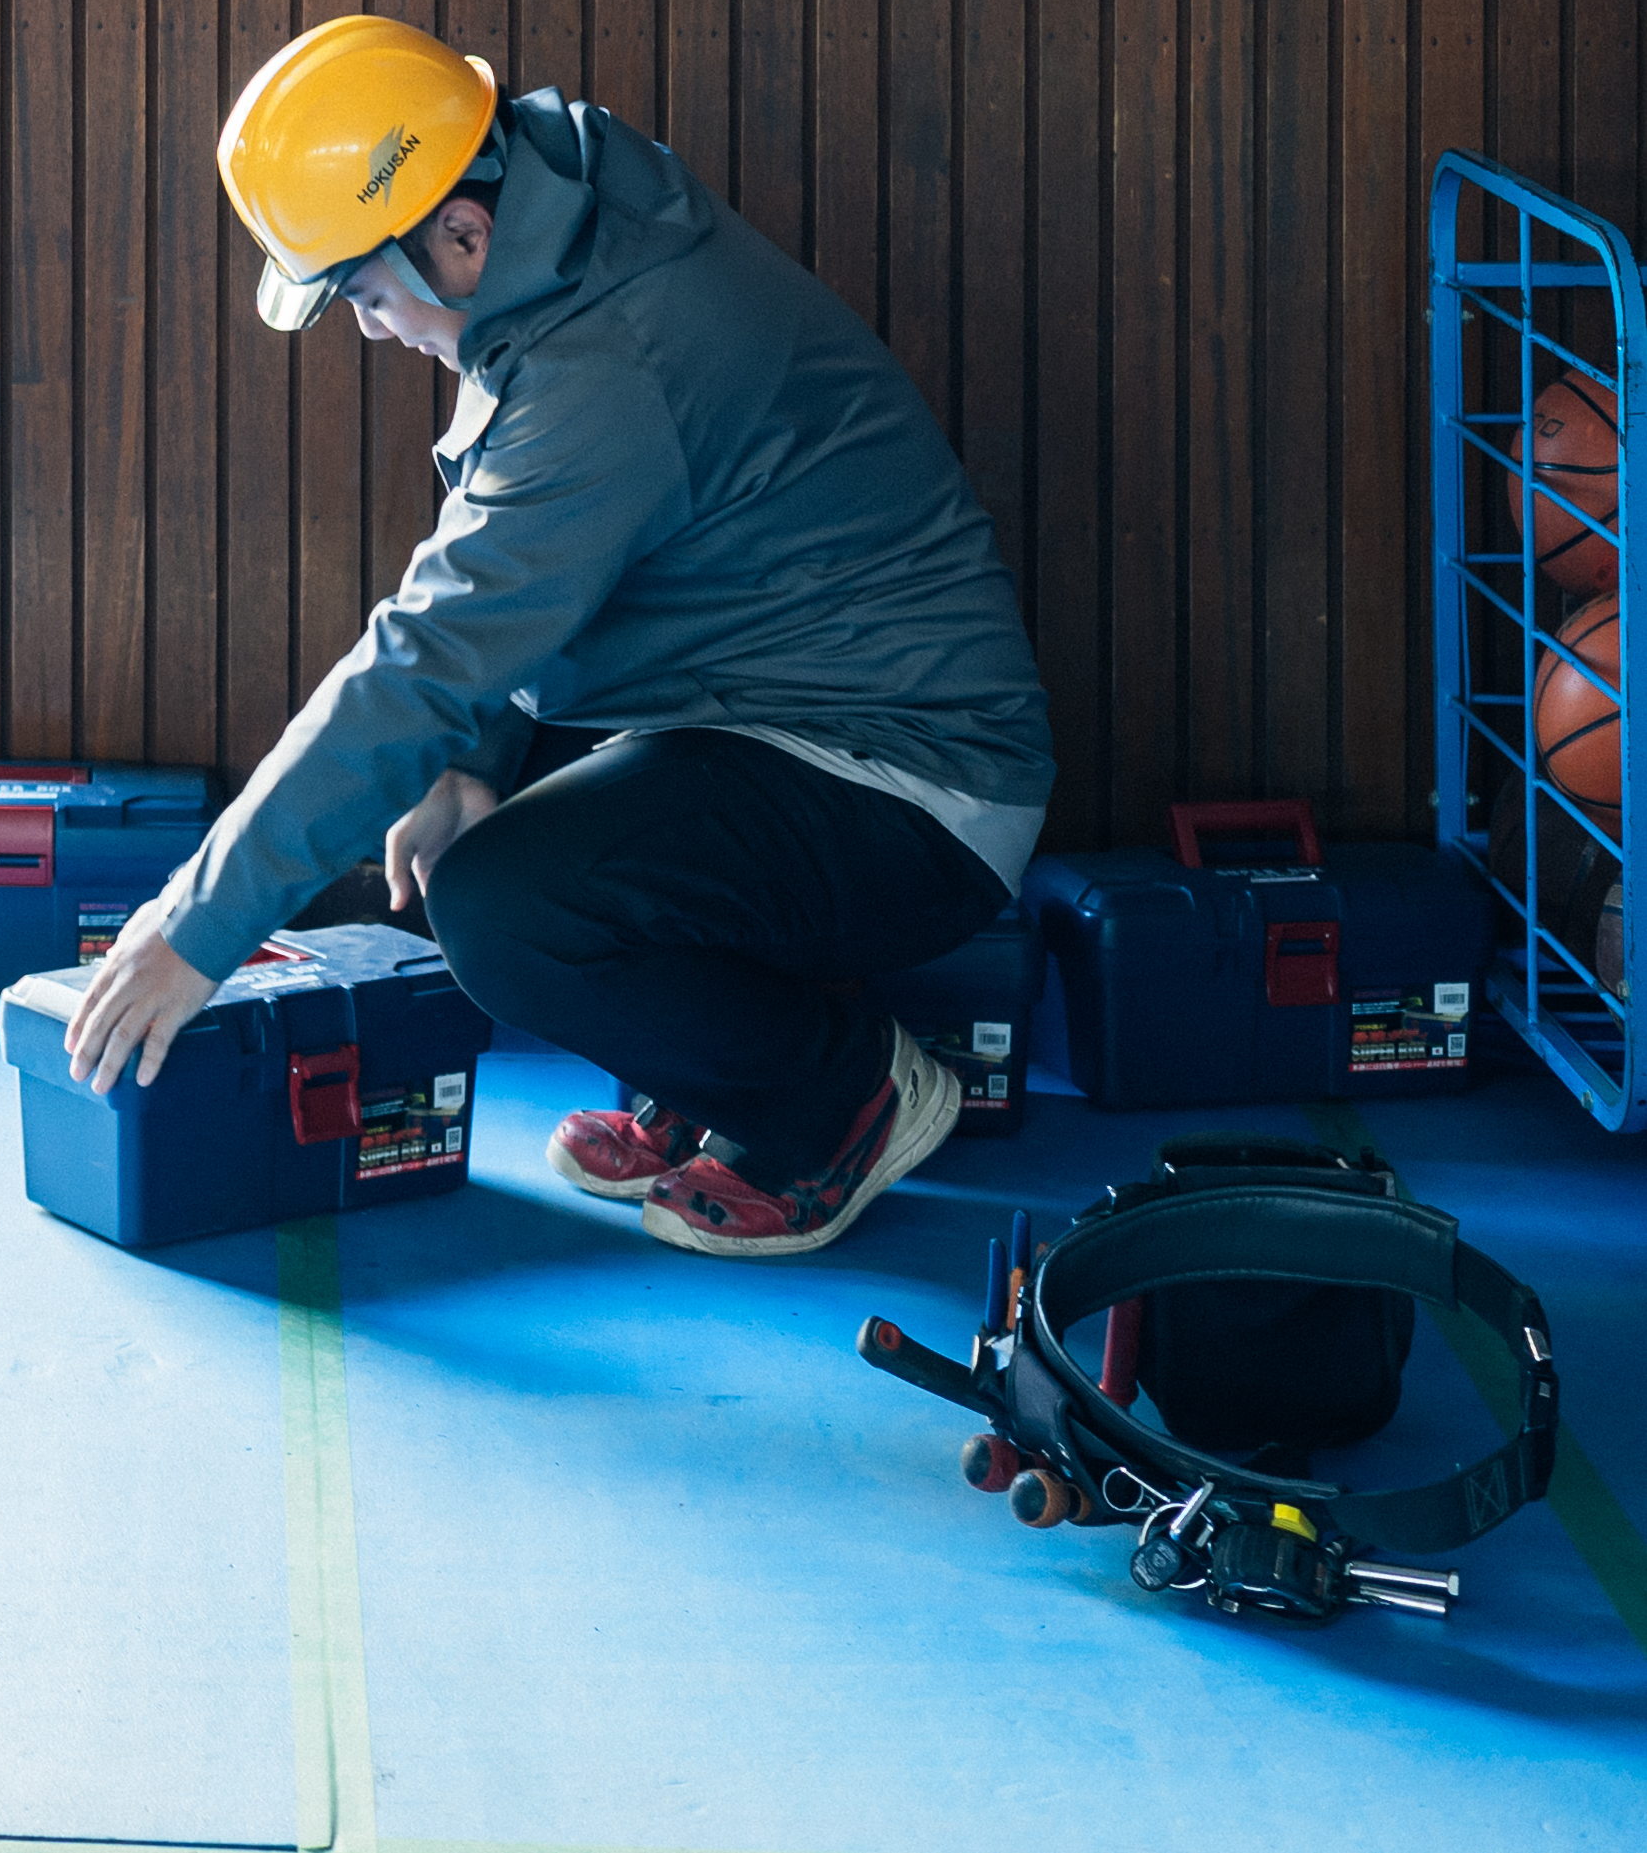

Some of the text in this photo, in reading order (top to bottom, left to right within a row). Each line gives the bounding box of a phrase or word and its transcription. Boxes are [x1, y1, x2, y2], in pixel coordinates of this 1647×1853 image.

[356, 134, 421, 204] HOKUSAN
[1351, 1042, 1426, 1062] SUPER BOX
